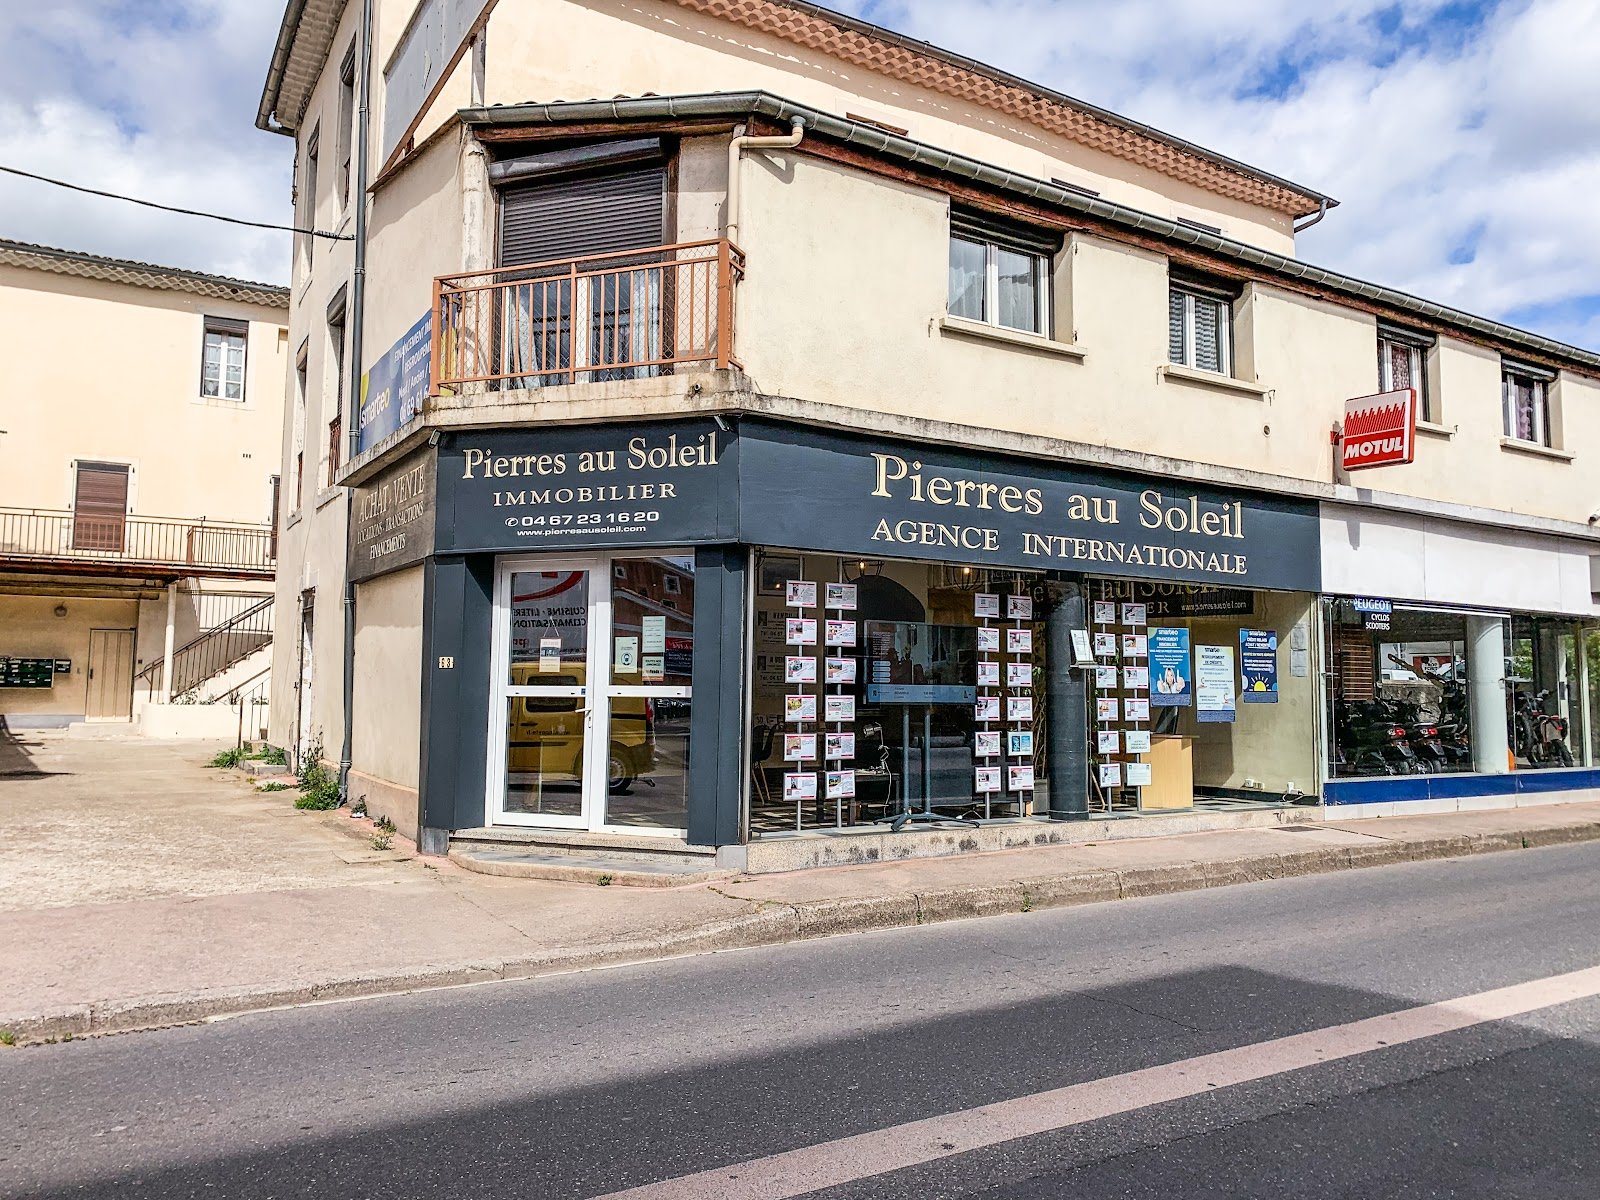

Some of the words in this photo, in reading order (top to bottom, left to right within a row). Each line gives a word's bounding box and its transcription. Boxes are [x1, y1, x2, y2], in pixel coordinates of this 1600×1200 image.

[361, 388, 391, 429] smarteo
[407, 396, 415, 417] 69
[462, 448, 566, 480] Pierres
[578, 450, 617, 474] au
[627, 431, 719, 470] Soleil
[1344, 437, 1403, 459] MOTUL
[358, 484, 389, 524] ACHAT
[393, 463, 425, 506] VENTE
[493, 483, 677, 507] IMMOBILIER
[870, 453, 1043, 515] Pierres
[1068, 494, 1120, 524] au
[1139, 489, 1245, 539] Soleil
[385, 500, 424, 532] TRANSACTIONS
[521, 514, 545, 527] 04
[549, 513, 573, 526] 67
[577, 513, 602, 525] 23
[606, 511, 630, 524] 16
[633, 511, 659, 523] 20
[516, 525, 647, 537] www.pierresausoleil.com
[369, 532, 406, 560] FINANCEMENTS
[871, 518, 1000, 551] AGENCE
[1022, 533, 1248, 575] INTERNATIONALE
[1354, 598, 1390, 611] PEUGEOT
